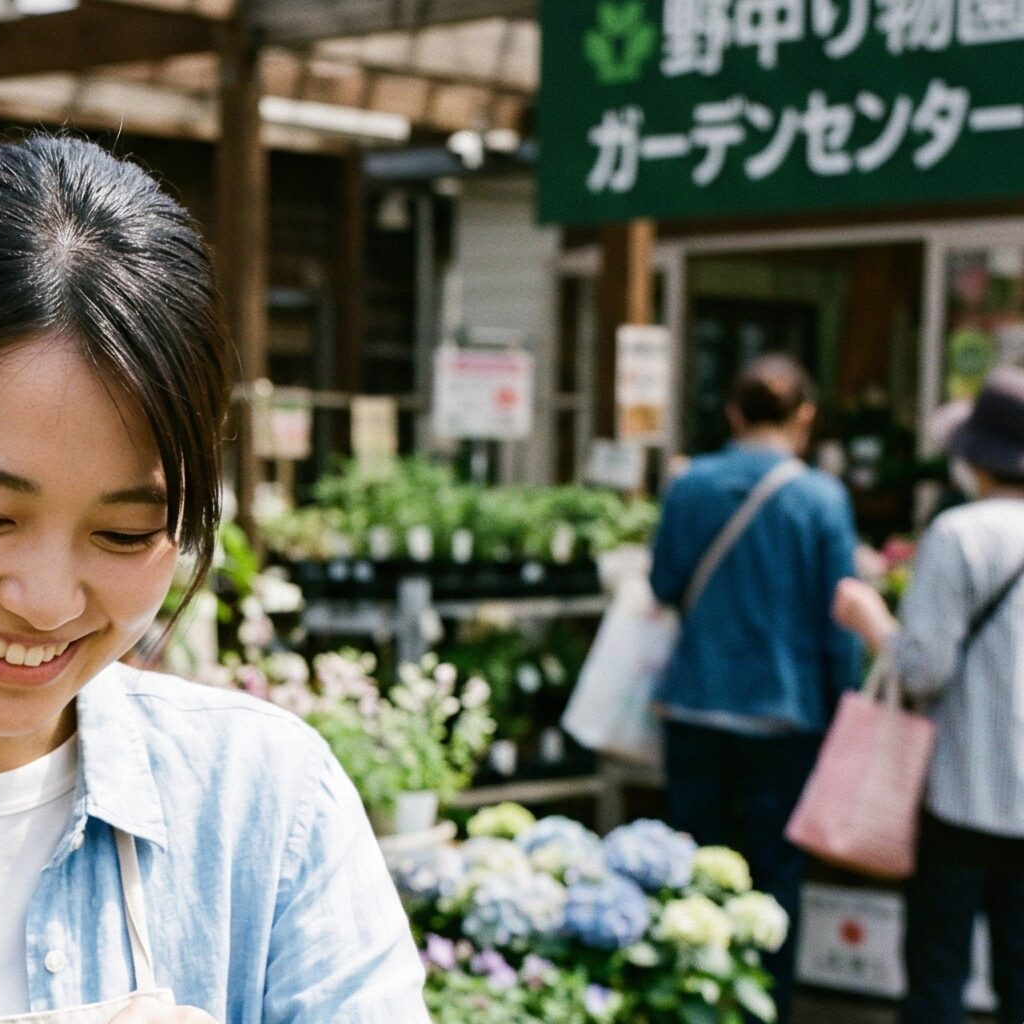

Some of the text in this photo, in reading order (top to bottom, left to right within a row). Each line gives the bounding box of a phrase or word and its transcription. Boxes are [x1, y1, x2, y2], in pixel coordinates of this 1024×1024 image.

[586, 79, 1024, 193] ガーデンセンター
